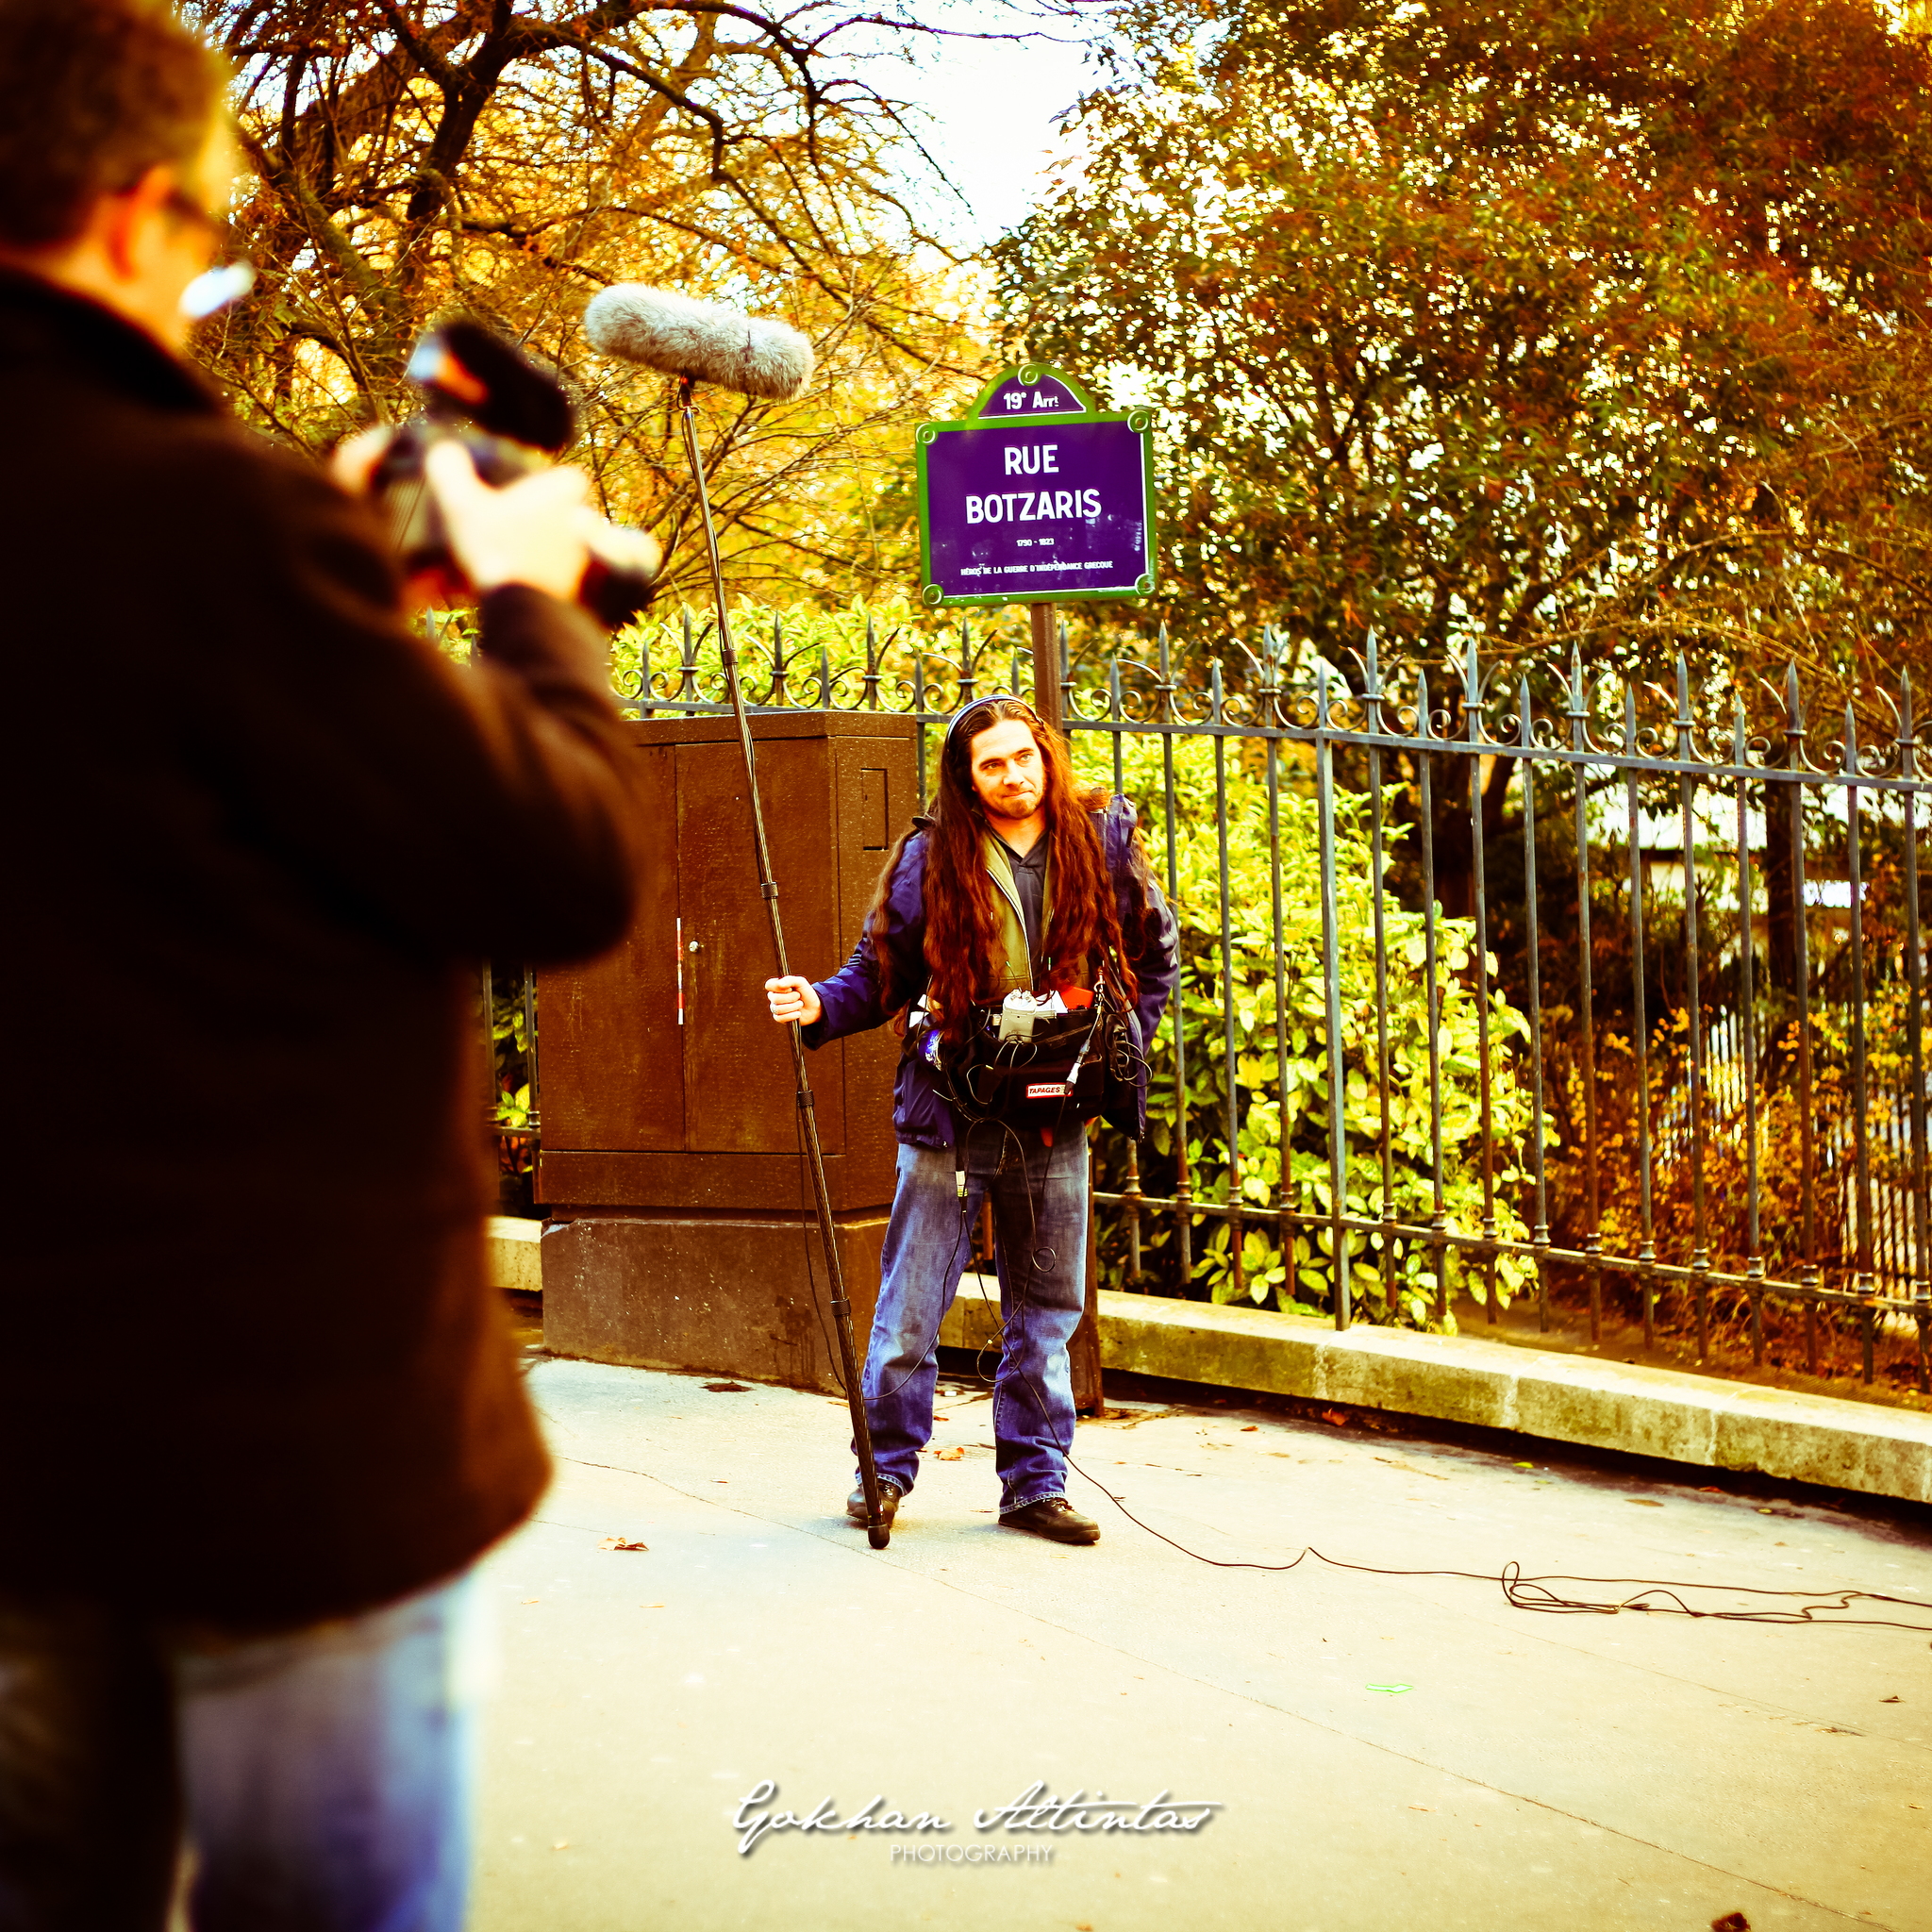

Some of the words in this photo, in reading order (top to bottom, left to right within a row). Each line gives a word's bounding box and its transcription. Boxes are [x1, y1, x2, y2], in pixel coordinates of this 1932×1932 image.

[1004, 444, 1059, 475] RUE
[965, 488, 1102, 525] BOTZARIS
[1016, 539, 1033, 547] 1790
[1038, 538, 1055, 546] 1823
[1004, 564, 1028, 574] GUERRE
[1084, 560, 1113, 570] GRECQUE
